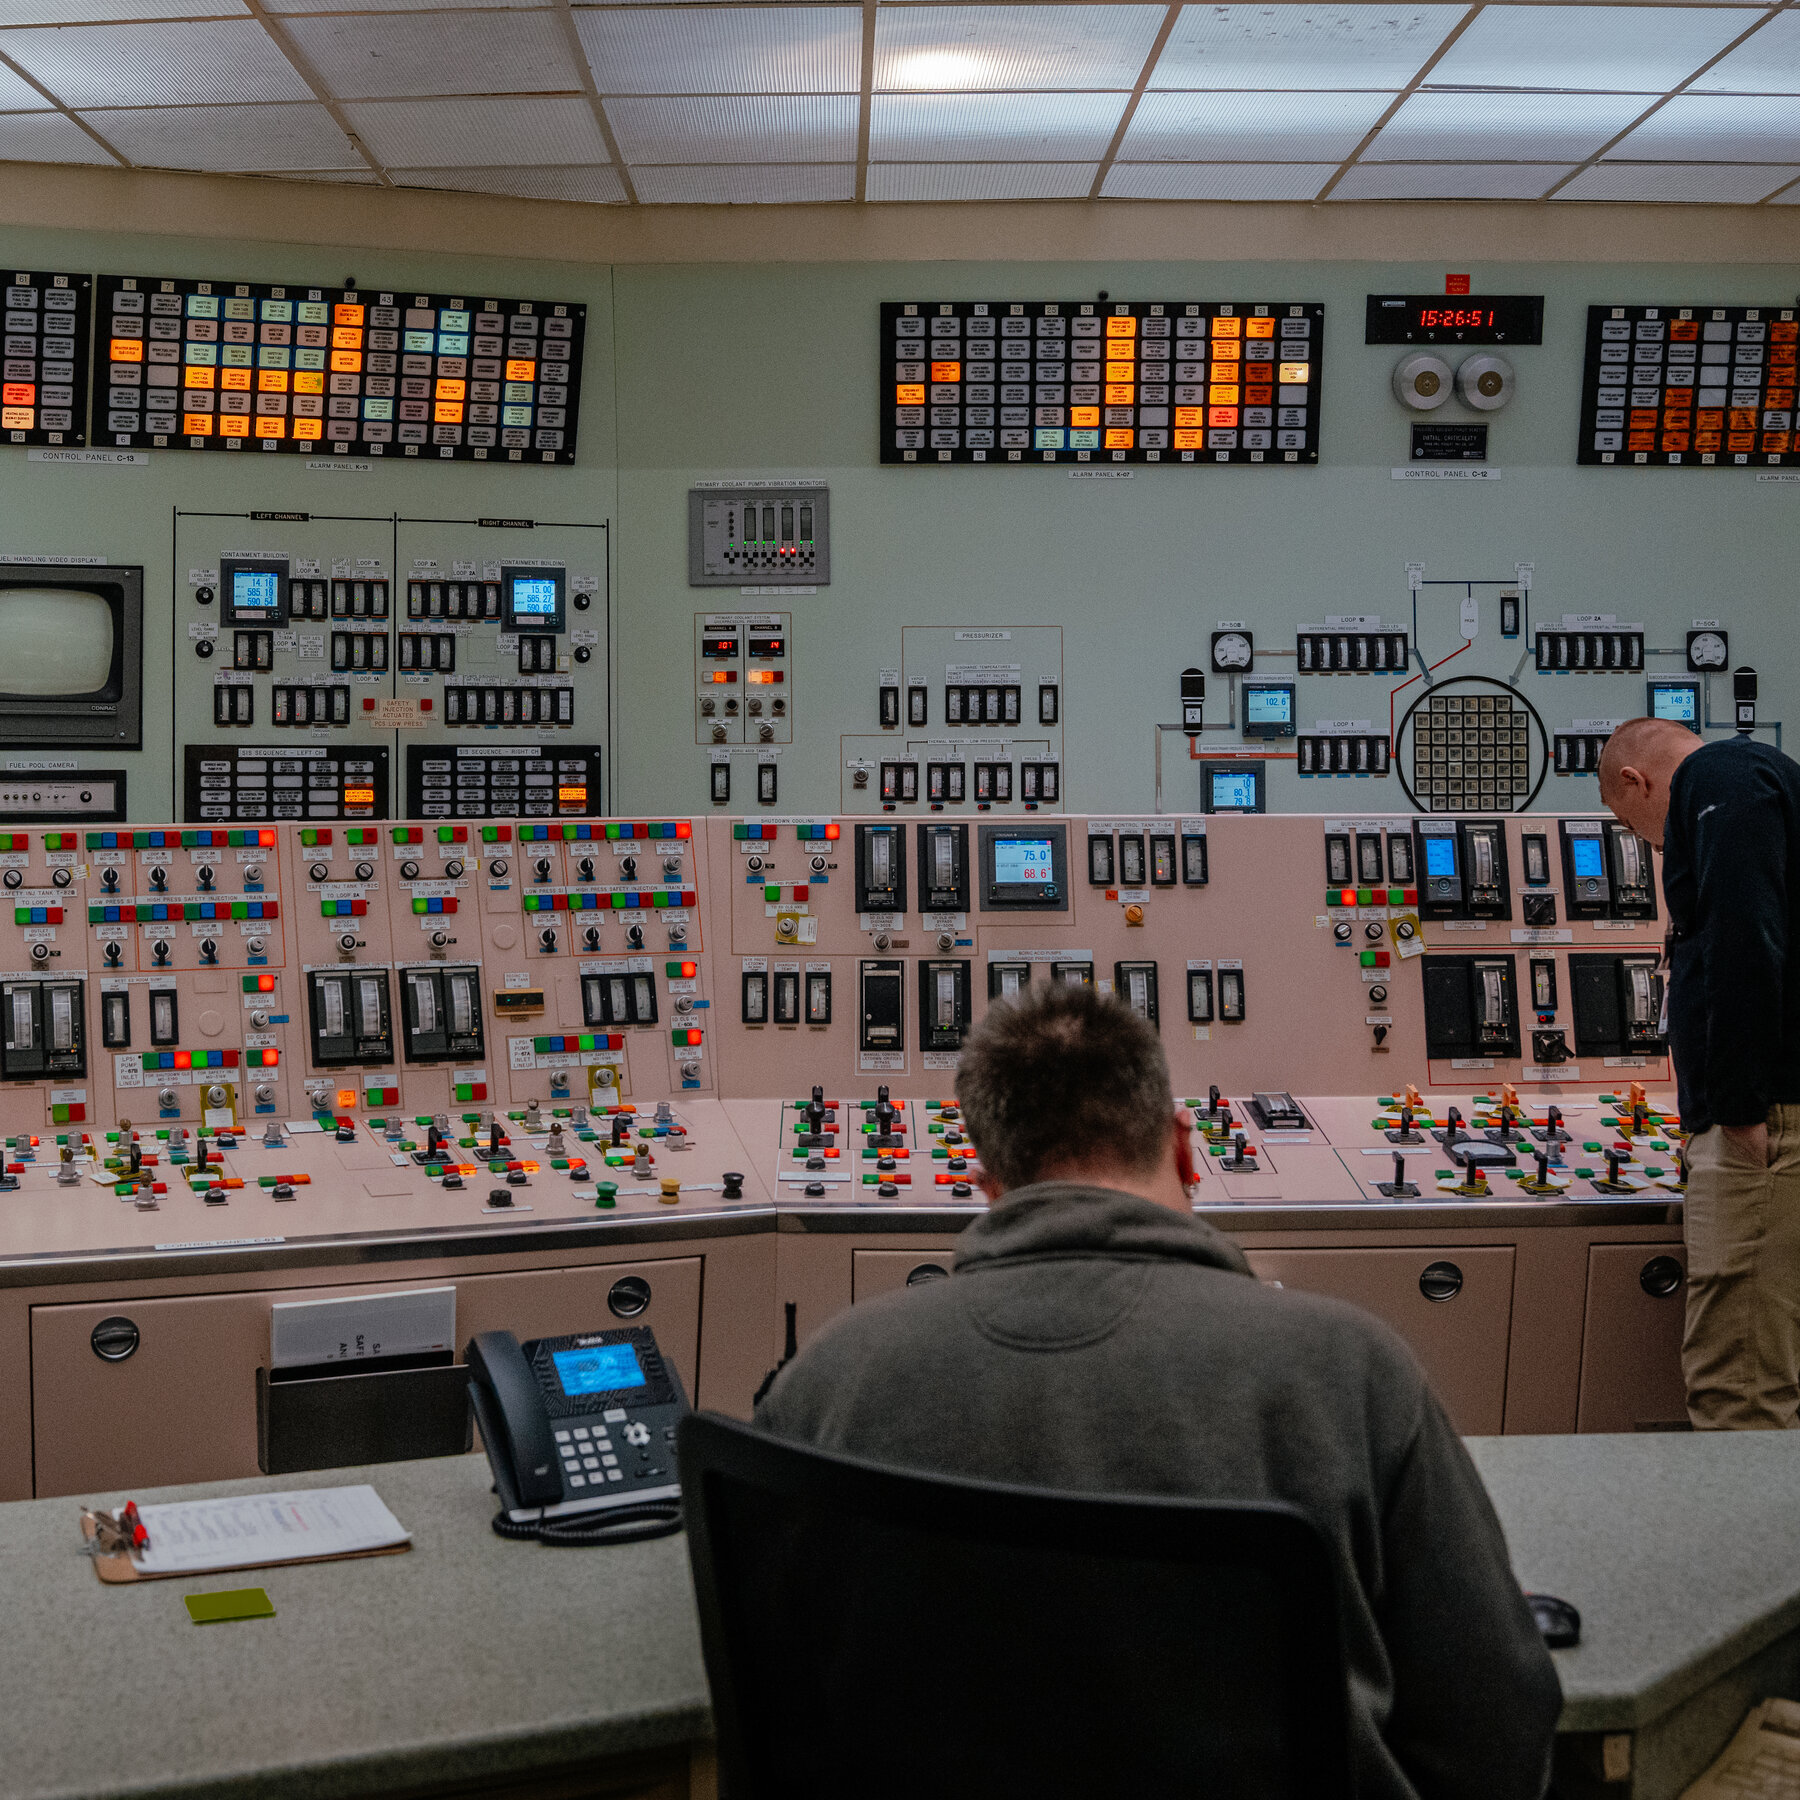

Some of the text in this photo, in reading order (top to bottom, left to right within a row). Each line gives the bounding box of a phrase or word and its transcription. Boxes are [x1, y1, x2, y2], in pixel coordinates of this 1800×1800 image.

[1420, 310, 1494, 326] 15:26:51
[247, 588, 274, 596] 585.19
[1671, 696, 1690, 704] 149.3
[1024, 850, 1046, 861] 75.0
[1024, 868, 1047, 879] 68.6
